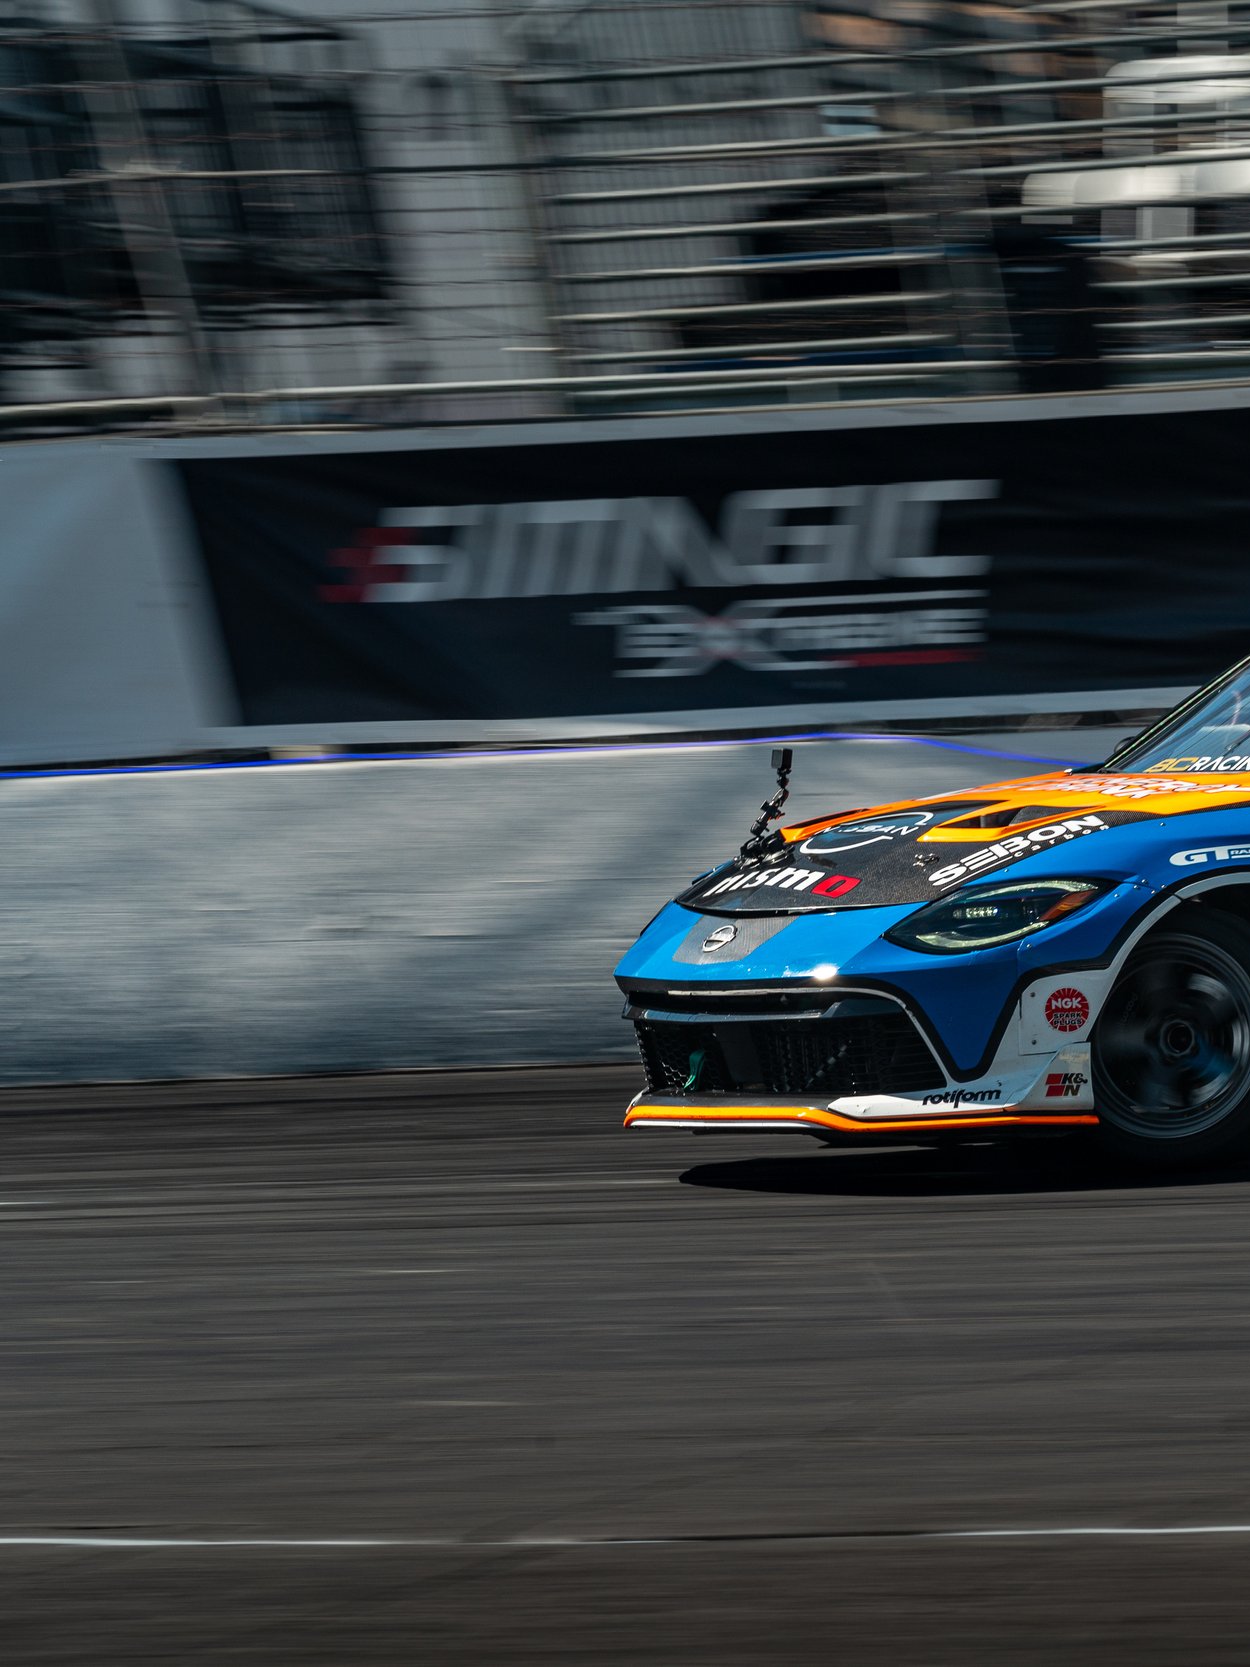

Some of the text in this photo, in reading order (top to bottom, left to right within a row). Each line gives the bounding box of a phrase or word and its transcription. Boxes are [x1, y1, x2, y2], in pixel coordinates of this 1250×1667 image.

[1169, 844, 1250, 866] GT
[1051, 997, 1082, 1010] NGK
[1053, 1018, 1082, 1027] PLUGS
[922, 1088, 1003, 1109] rotiform
